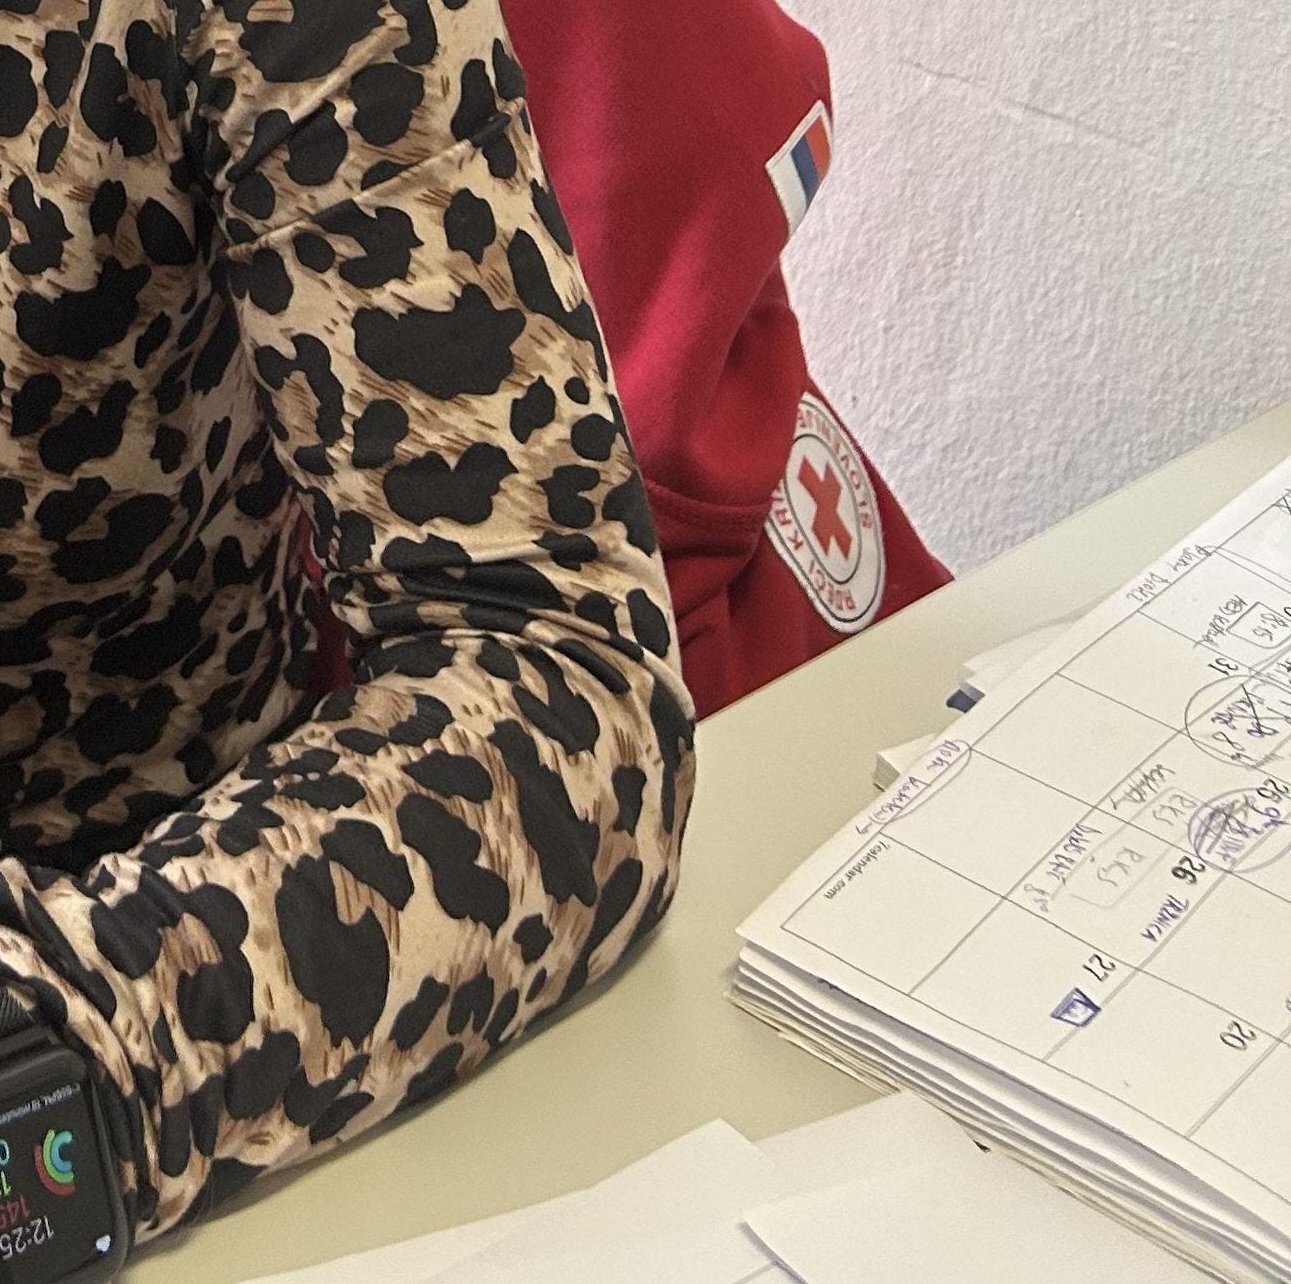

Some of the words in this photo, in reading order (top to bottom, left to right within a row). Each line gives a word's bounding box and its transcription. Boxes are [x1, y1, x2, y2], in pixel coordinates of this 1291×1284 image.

[1208, 657, 1238, 676] 31
[1172, 856, 1206, 885] 26
[1083, 954, 1116, 982] 27
[1219, 1020, 1257, 1051] 20
